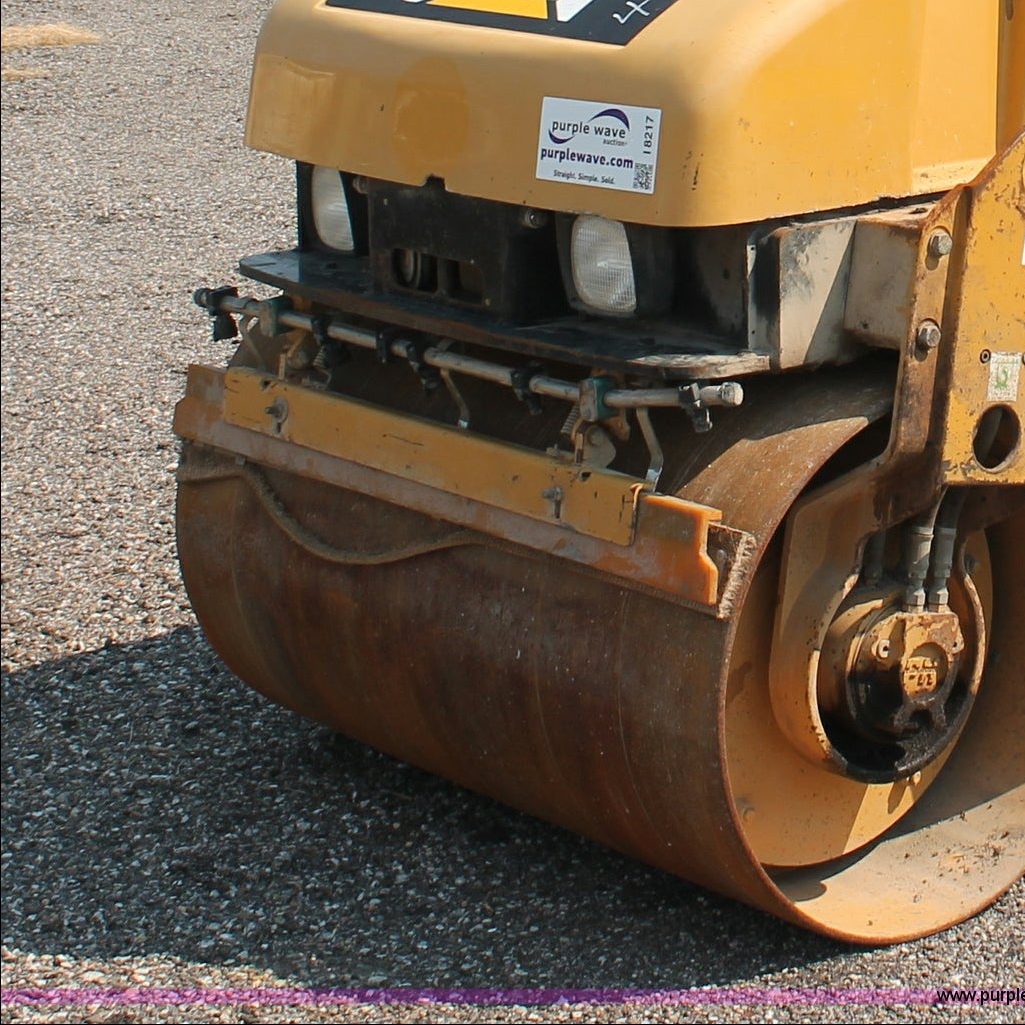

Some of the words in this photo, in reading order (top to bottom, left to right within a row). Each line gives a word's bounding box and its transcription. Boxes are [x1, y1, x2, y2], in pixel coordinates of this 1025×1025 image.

[552, 121, 590, 135] purple
[594, 126, 626, 139] wave
[643, 115, 655, 155] 18217
[541, 147, 634, 169] purplewave.com
[553, 169, 576, 180] Straight.
[577, 172, 600, 183] Simple.
[601, 175, 616, 185] Sold.
